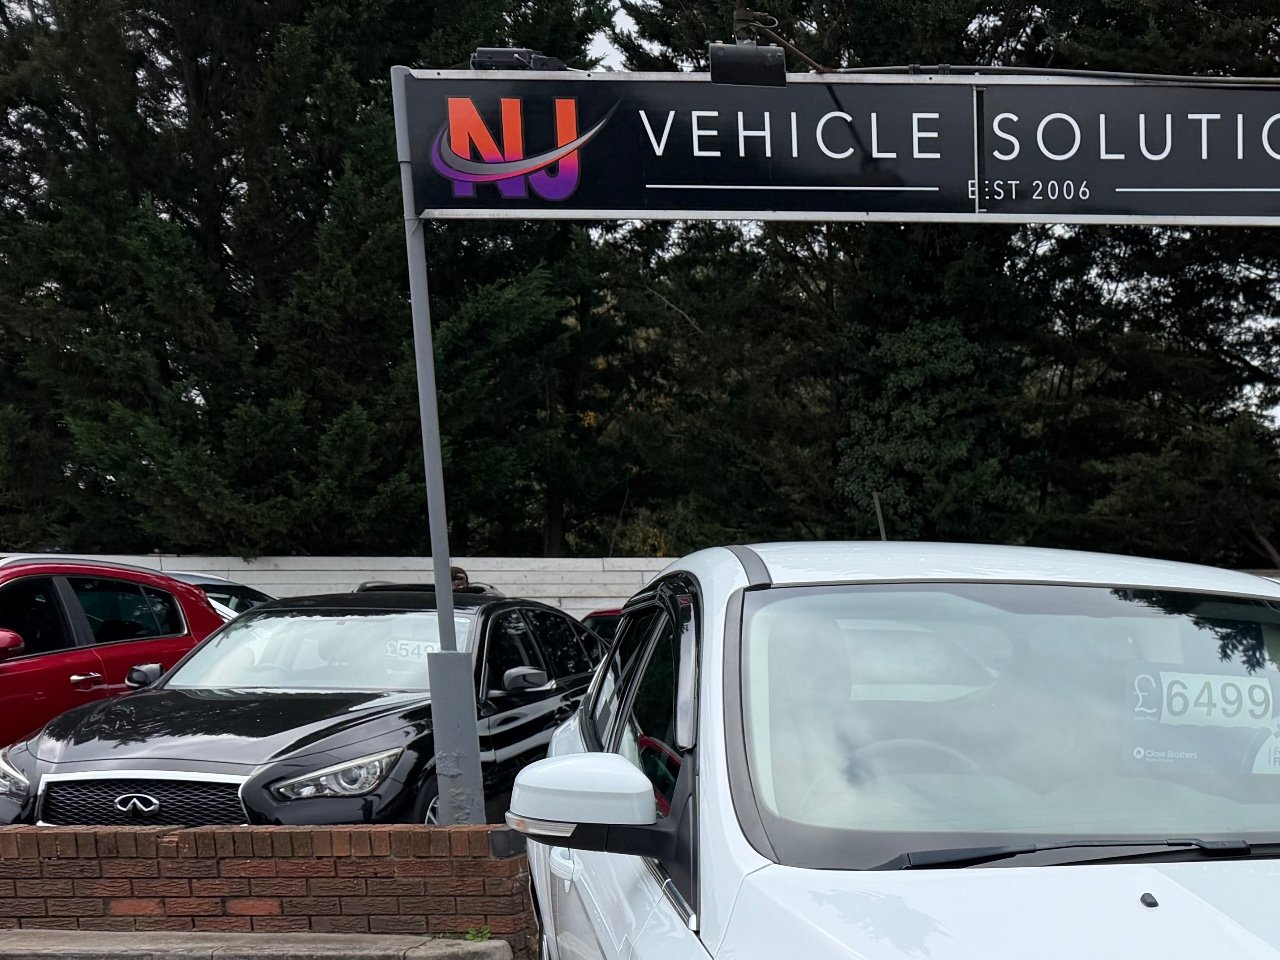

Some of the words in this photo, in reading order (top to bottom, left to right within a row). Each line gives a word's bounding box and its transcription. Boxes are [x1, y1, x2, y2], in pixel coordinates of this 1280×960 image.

[447, 97, 579, 200] NJ
[639, 109, 942, 159] VEHICLE
[967, 180, 1020, 200] EST
[1032, 179, 1091, 200] 2006
